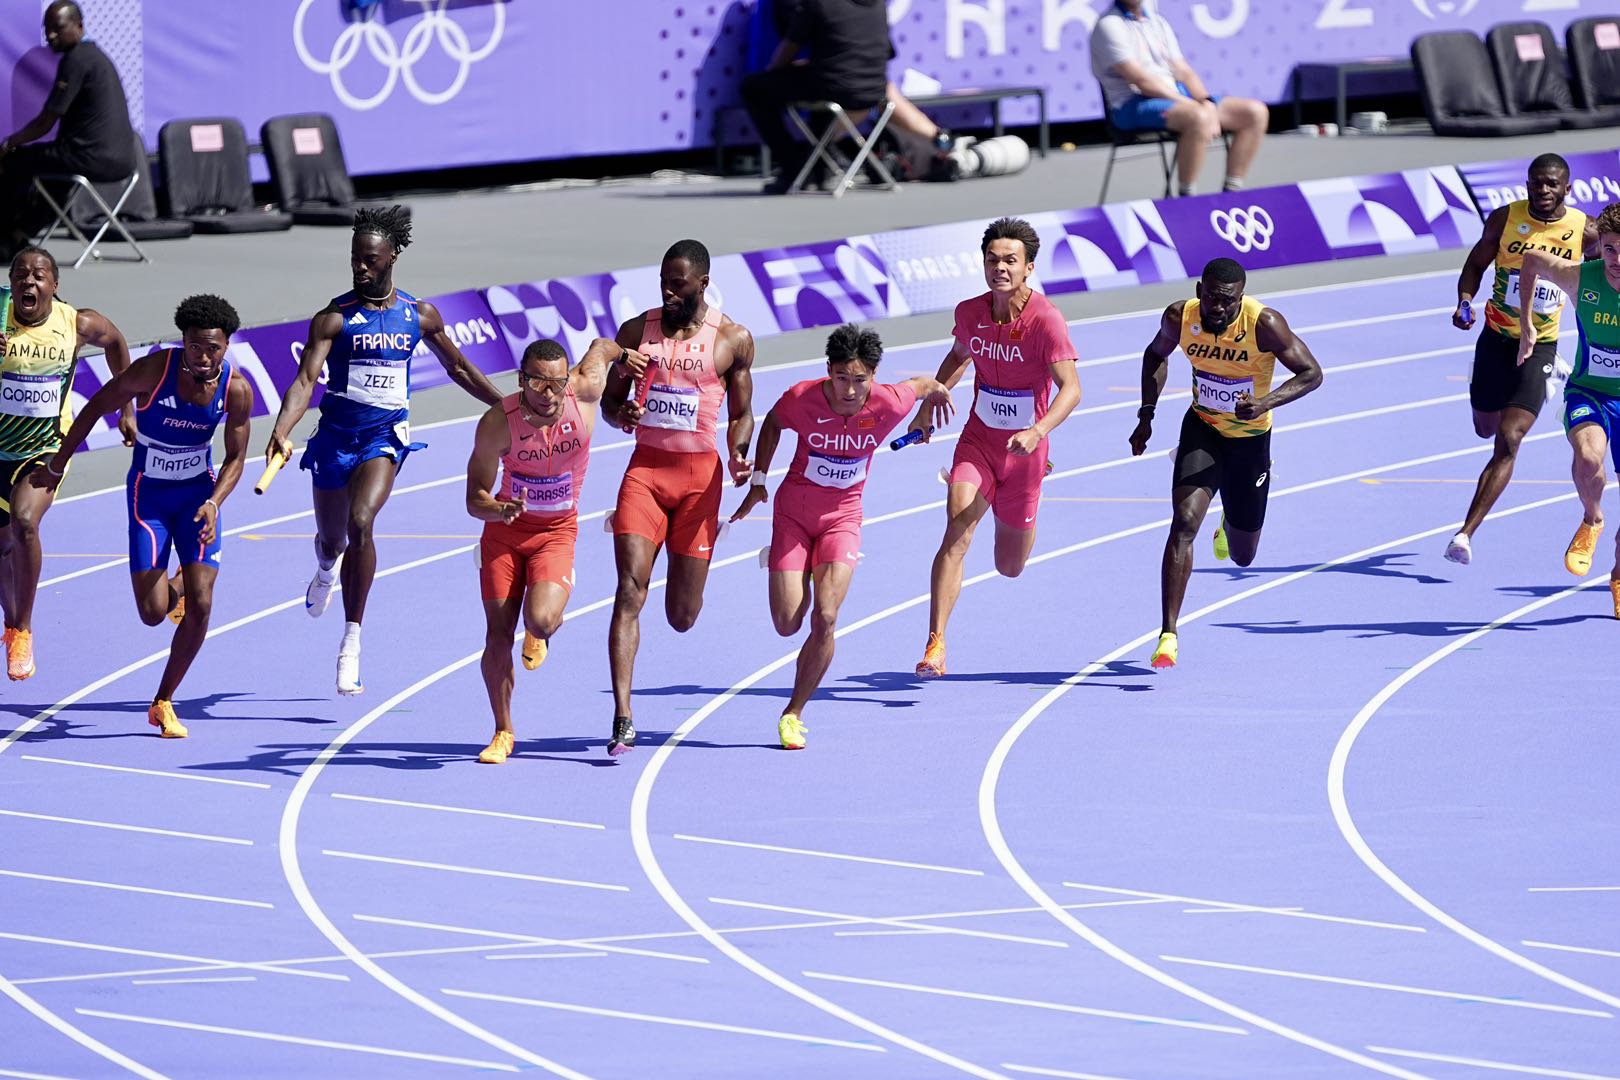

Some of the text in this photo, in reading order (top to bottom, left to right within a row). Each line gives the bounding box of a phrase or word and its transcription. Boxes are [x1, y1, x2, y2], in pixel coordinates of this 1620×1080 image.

[1486, 185, 1529, 209] PAR
[897, 253, 960, 282] PARIS
[1593, 312, 1620, 326] BRA
[444, 316, 498, 349] 2024
[352, 333, 411, 352] FRANCE
[970, 336, 1025, 363] CHINA
[1186, 342, 1249, 362] GHANA
[363, 373, 395, 389] ZEZE
[2, 387, 58, 403] GORDON
[1199, 384, 1251, 402] AMOA
[991, 401, 1018, 417] YAN
[162, 417, 211, 431] FRANCE
[517, 438, 582, 462] CANADA
[807, 432, 878, 451] CHINA
[152, 455, 201, 472] MATEO
[817, 465, 858, 480] CHEN
[527, 483, 571, 500] GRASSE
